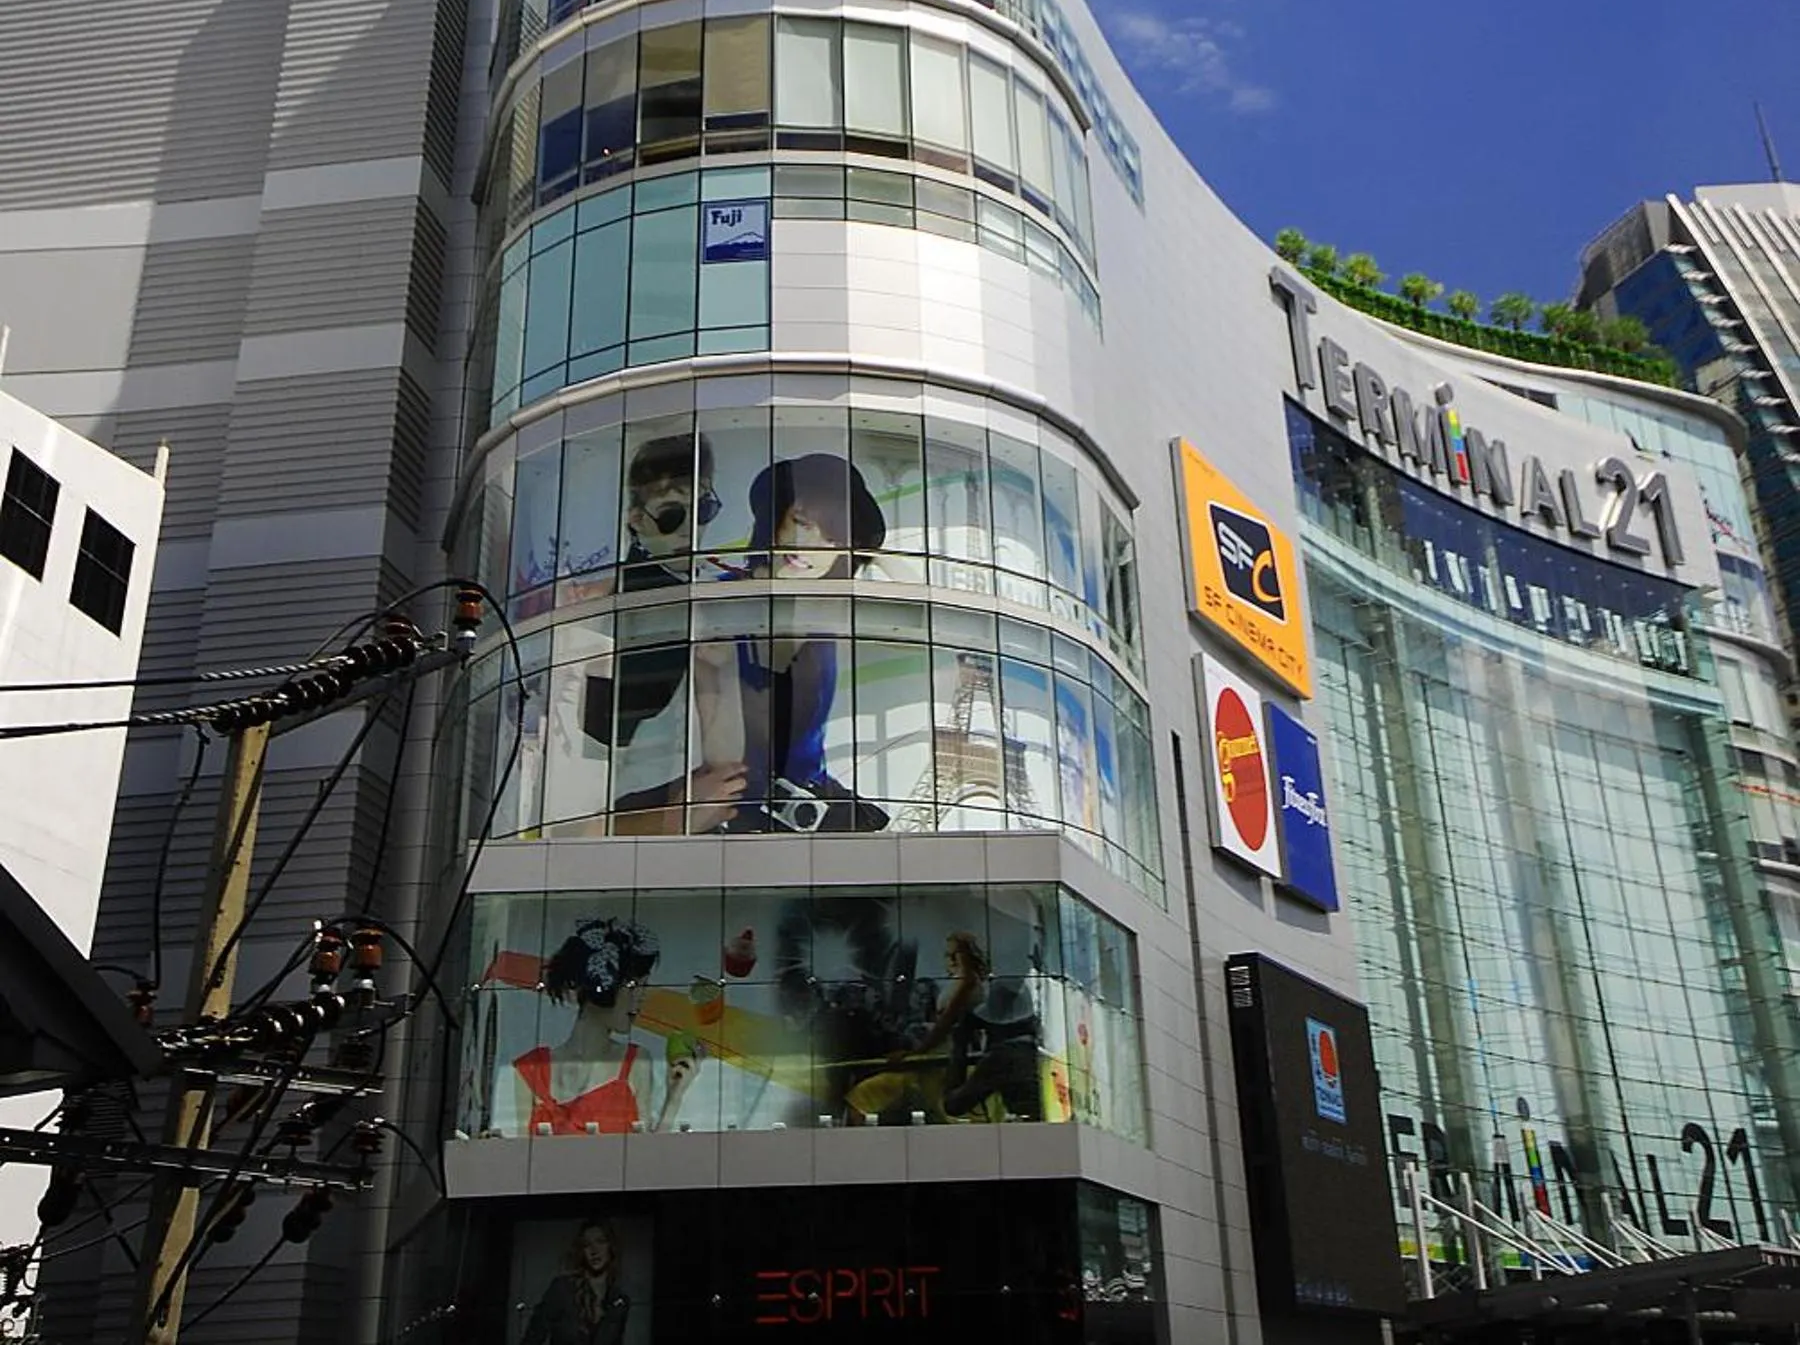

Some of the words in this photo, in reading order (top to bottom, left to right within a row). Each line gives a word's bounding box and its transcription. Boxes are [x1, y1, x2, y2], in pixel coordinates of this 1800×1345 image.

[711, 209, 743, 227] Fuji
[1204, 584, 1223, 610] SF
[755, 1266, 941, 1323] ESPRIT
